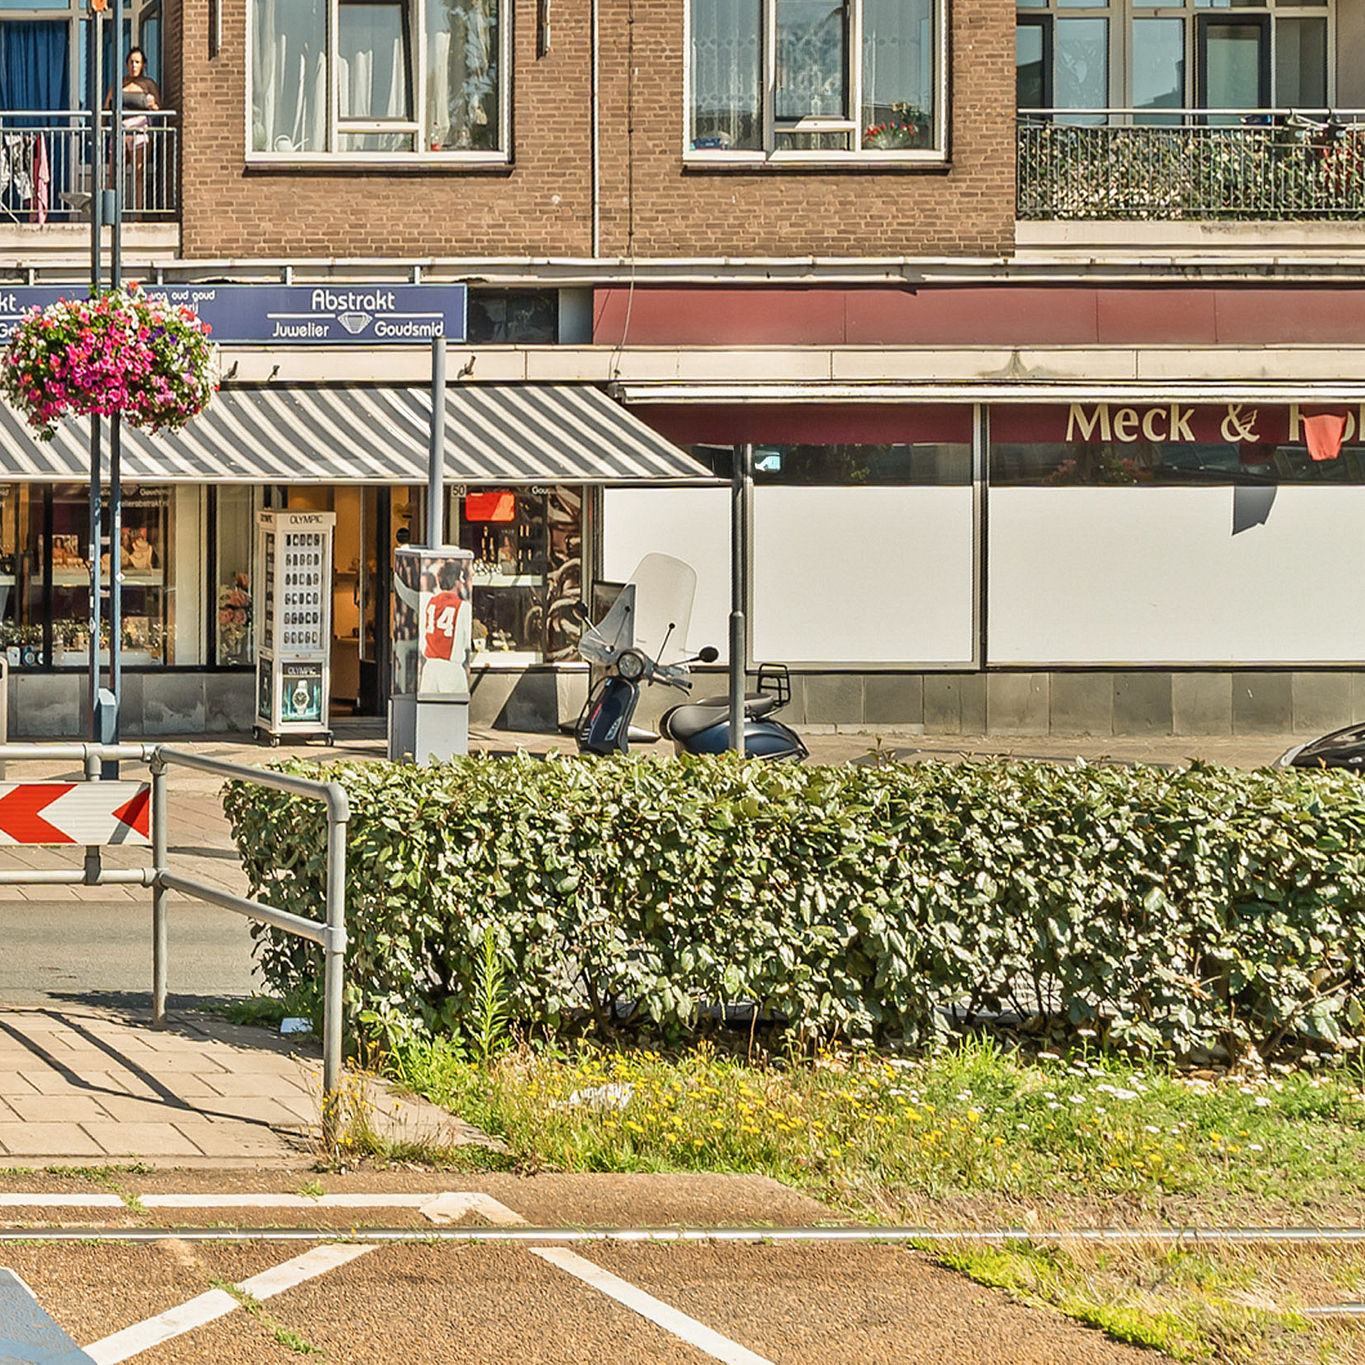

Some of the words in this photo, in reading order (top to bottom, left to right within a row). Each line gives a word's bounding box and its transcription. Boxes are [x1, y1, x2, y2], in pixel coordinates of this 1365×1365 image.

[171, 290, 189, 300] oud
[192, 289, 216, 302] goud
[311, 289, 395, 311] Abstrakt
[272, 321, 330, 338] Juwelier
[374, 321, 444, 337] Goudsmid
[1065, 403, 1196, 442] Meck
[452, 485, 466, 495] 50
[290, 514, 324, 524] OLYMPIC
[426, 604, 456, 637] 14
